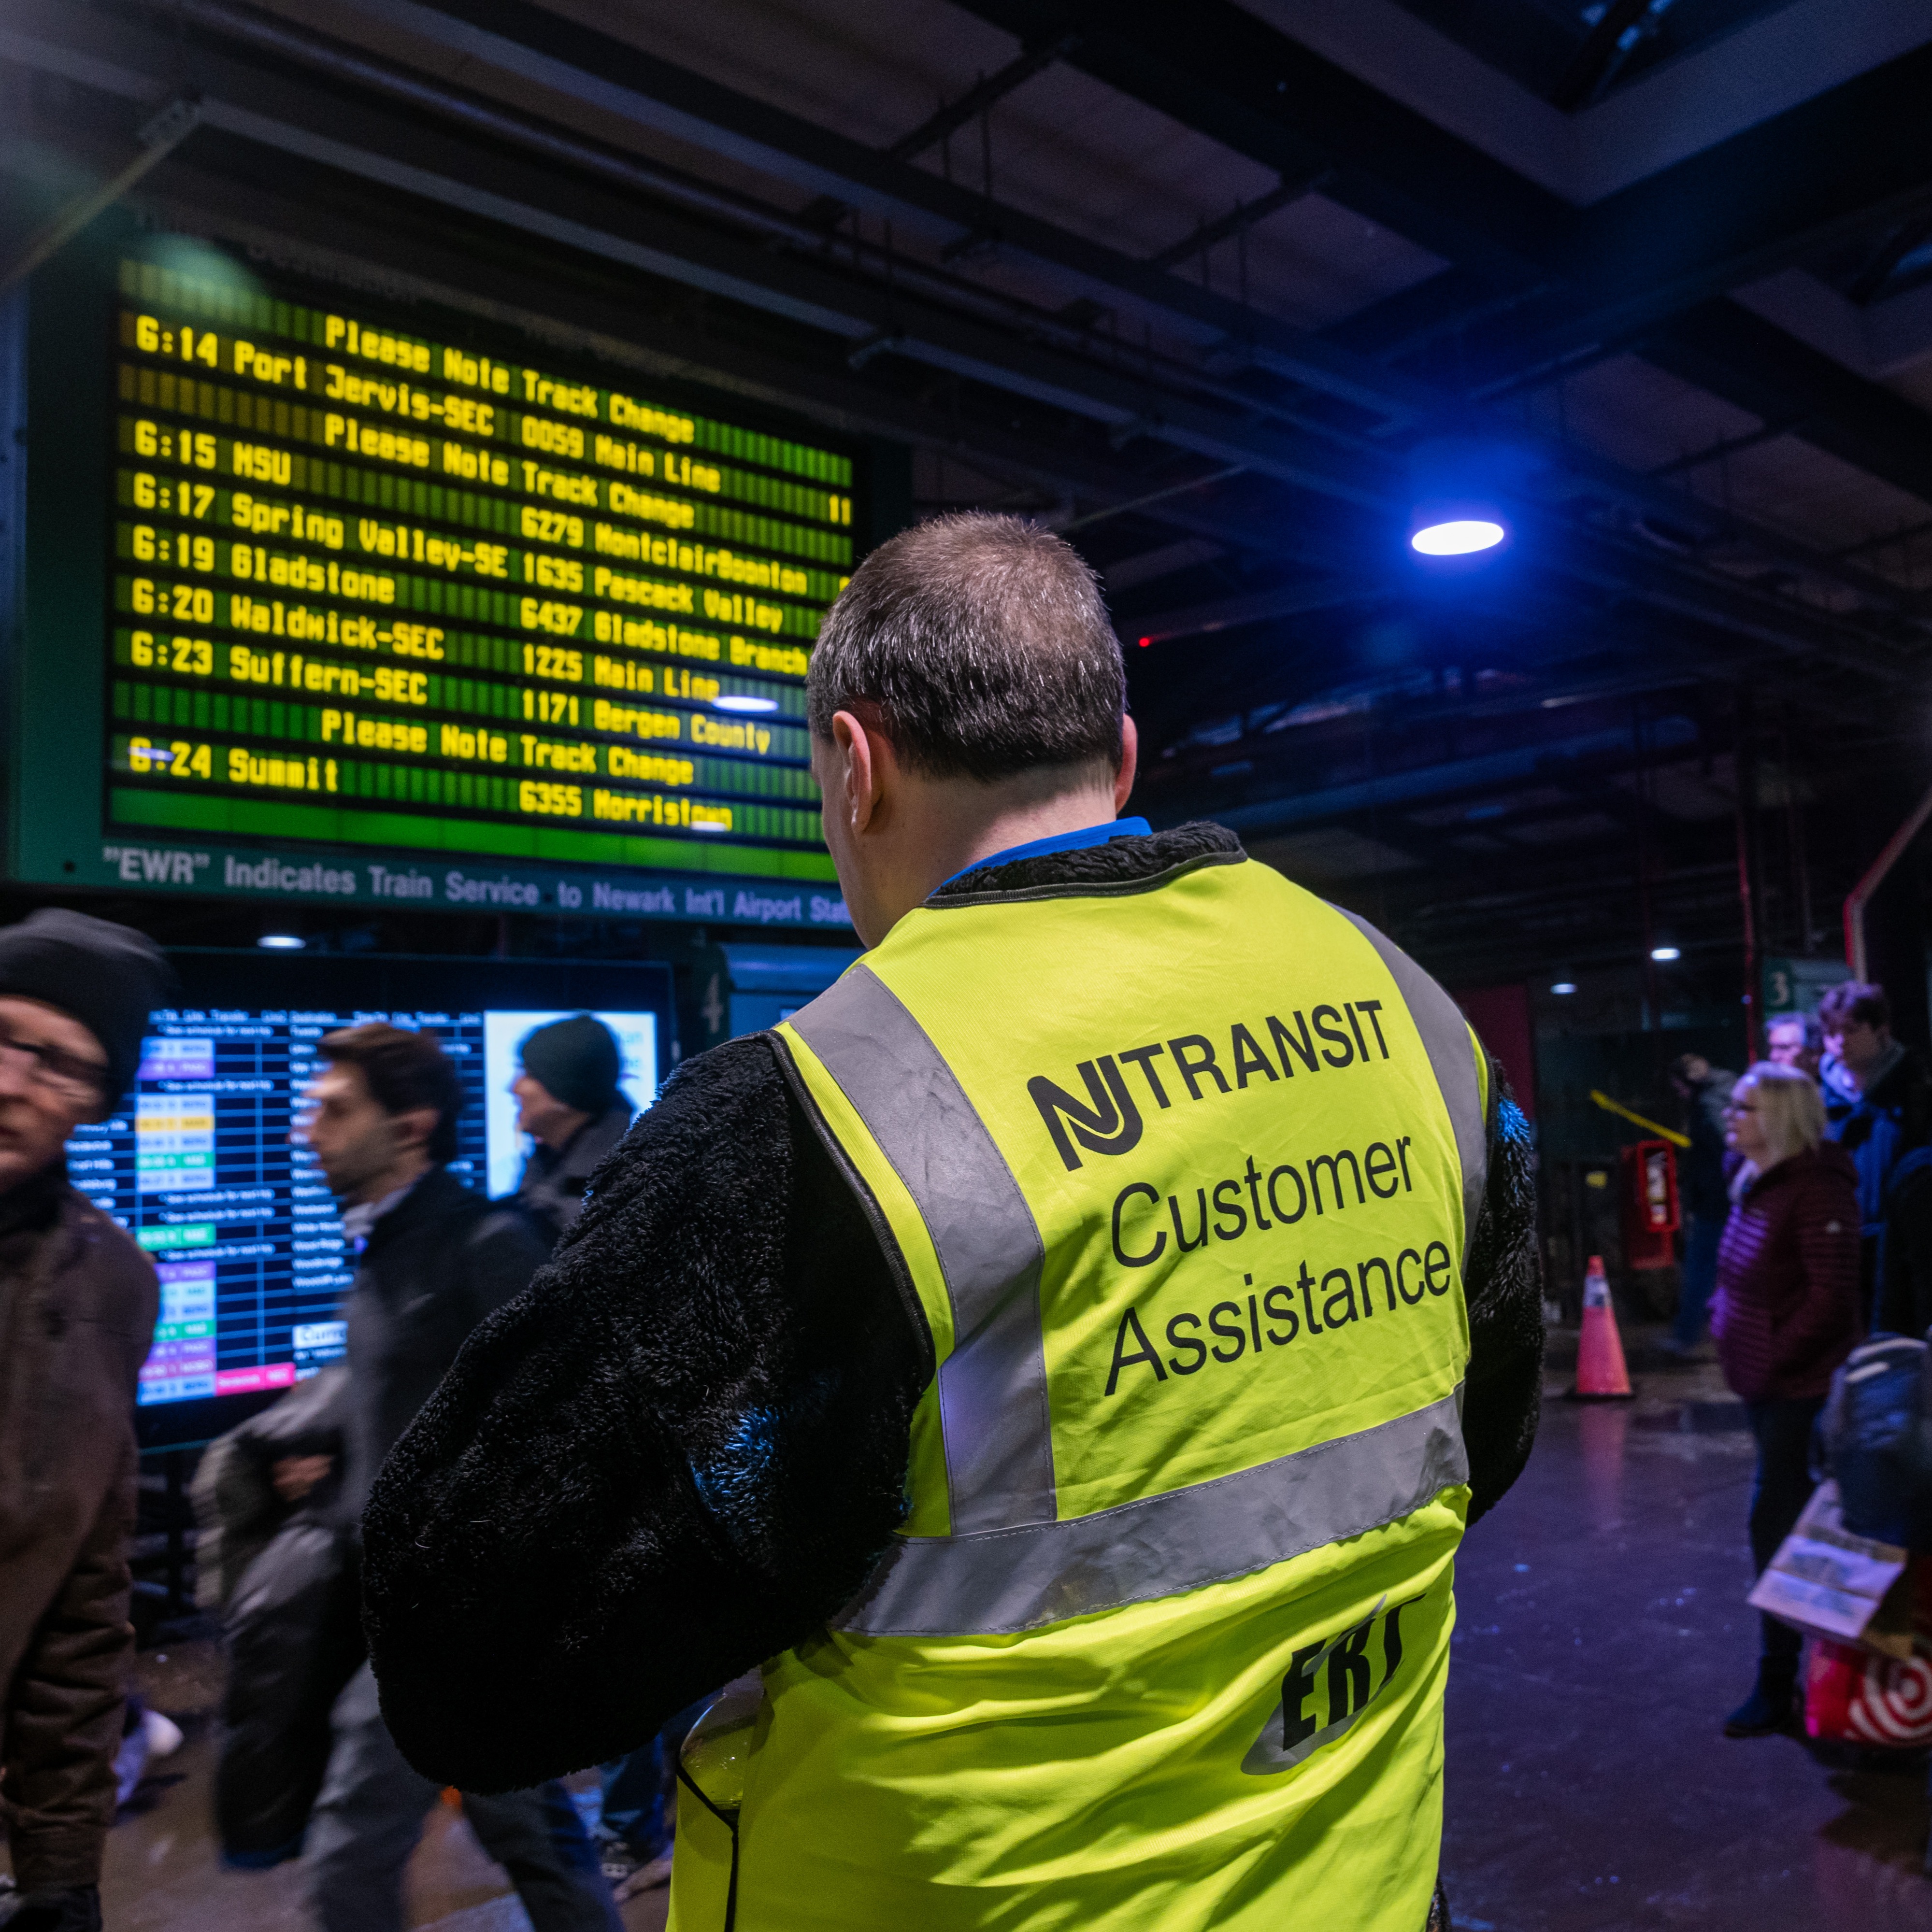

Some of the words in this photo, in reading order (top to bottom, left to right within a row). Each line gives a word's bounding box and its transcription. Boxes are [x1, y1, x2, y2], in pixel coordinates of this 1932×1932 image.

[136, 314, 218, 368] 6:14
[234, 340, 307, 390] Port
[325, 363, 495, 437] Jervis-SEC
[521, 415, 585, 459] 0059
[594, 433, 655, 477] Main
[664, 451, 721, 493] Line
[325, 314, 430, 374] Please
[443, 347, 510, 395] Note
[522, 369, 598, 419] Track
[609, 393, 695, 444] Change
[135, 419, 216, 470] 6:15
[521, 505, 585, 548] 6279
[324, 412, 430, 468] Please
[443, 440, 509, 487] Note
[521, 460, 599, 508] Track
[608, 481, 695, 529] Change
[133, 471, 215, 520] 6:17
[231, 492, 344, 550] Spring
[358, 518, 509, 579] Valley-SE
[523, 552, 584, 593] 1635
[594, 566, 694, 614] Pascack
[703, 588, 784, 634] Valley
[133, 525, 215, 572] 6:19
[231, 543, 395, 605] Gladstone
[520, 597, 584, 636] 6437
[594, 610, 721, 661] Gladstone
[729, 635, 809, 677] Branch
[131, 630, 214, 676] 6:23
[229, 645, 428, 706] Suffern-SEC
[523, 688, 579, 726] 1171
[593, 698, 681, 740] Bergen
[690, 713, 770, 753] County
[132, 577, 214, 624] 6:20
[230, 594, 444, 661] Waldwick-SEC
[523, 643, 583, 682] 1225
[593, 654, 654, 694] Main
[663, 666, 720, 702] Line
[129, 736, 212, 779] 6:24
[228, 747, 338, 792] Summit
[519, 780, 583, 817] 6355
[593, 788, 733, 831] Morristown
[321, 708, 428, 753] Please
[440, 723, 508, 763] Note
[520, 734, 597, 774] Track
[608, 745, 694, 787] Change
[103, 846, 210, 884] "EWR"
[225, 855, 357, 895] Indicates
[368, 866, 433, 899] Train
[445, 871, 539, 908] Service
[557, 880, 582, 909] to
[592, 881, 675, 912] Newark
[733, 891, 802, 923] Airport
[1771, 971, 1789, 1006] 3
[1119, 1000, 1390, 1109] TRANSIT
[1111, 1136, 1413, 1268] Customer
[1104, 1240, 1451, 1397] Assistance
